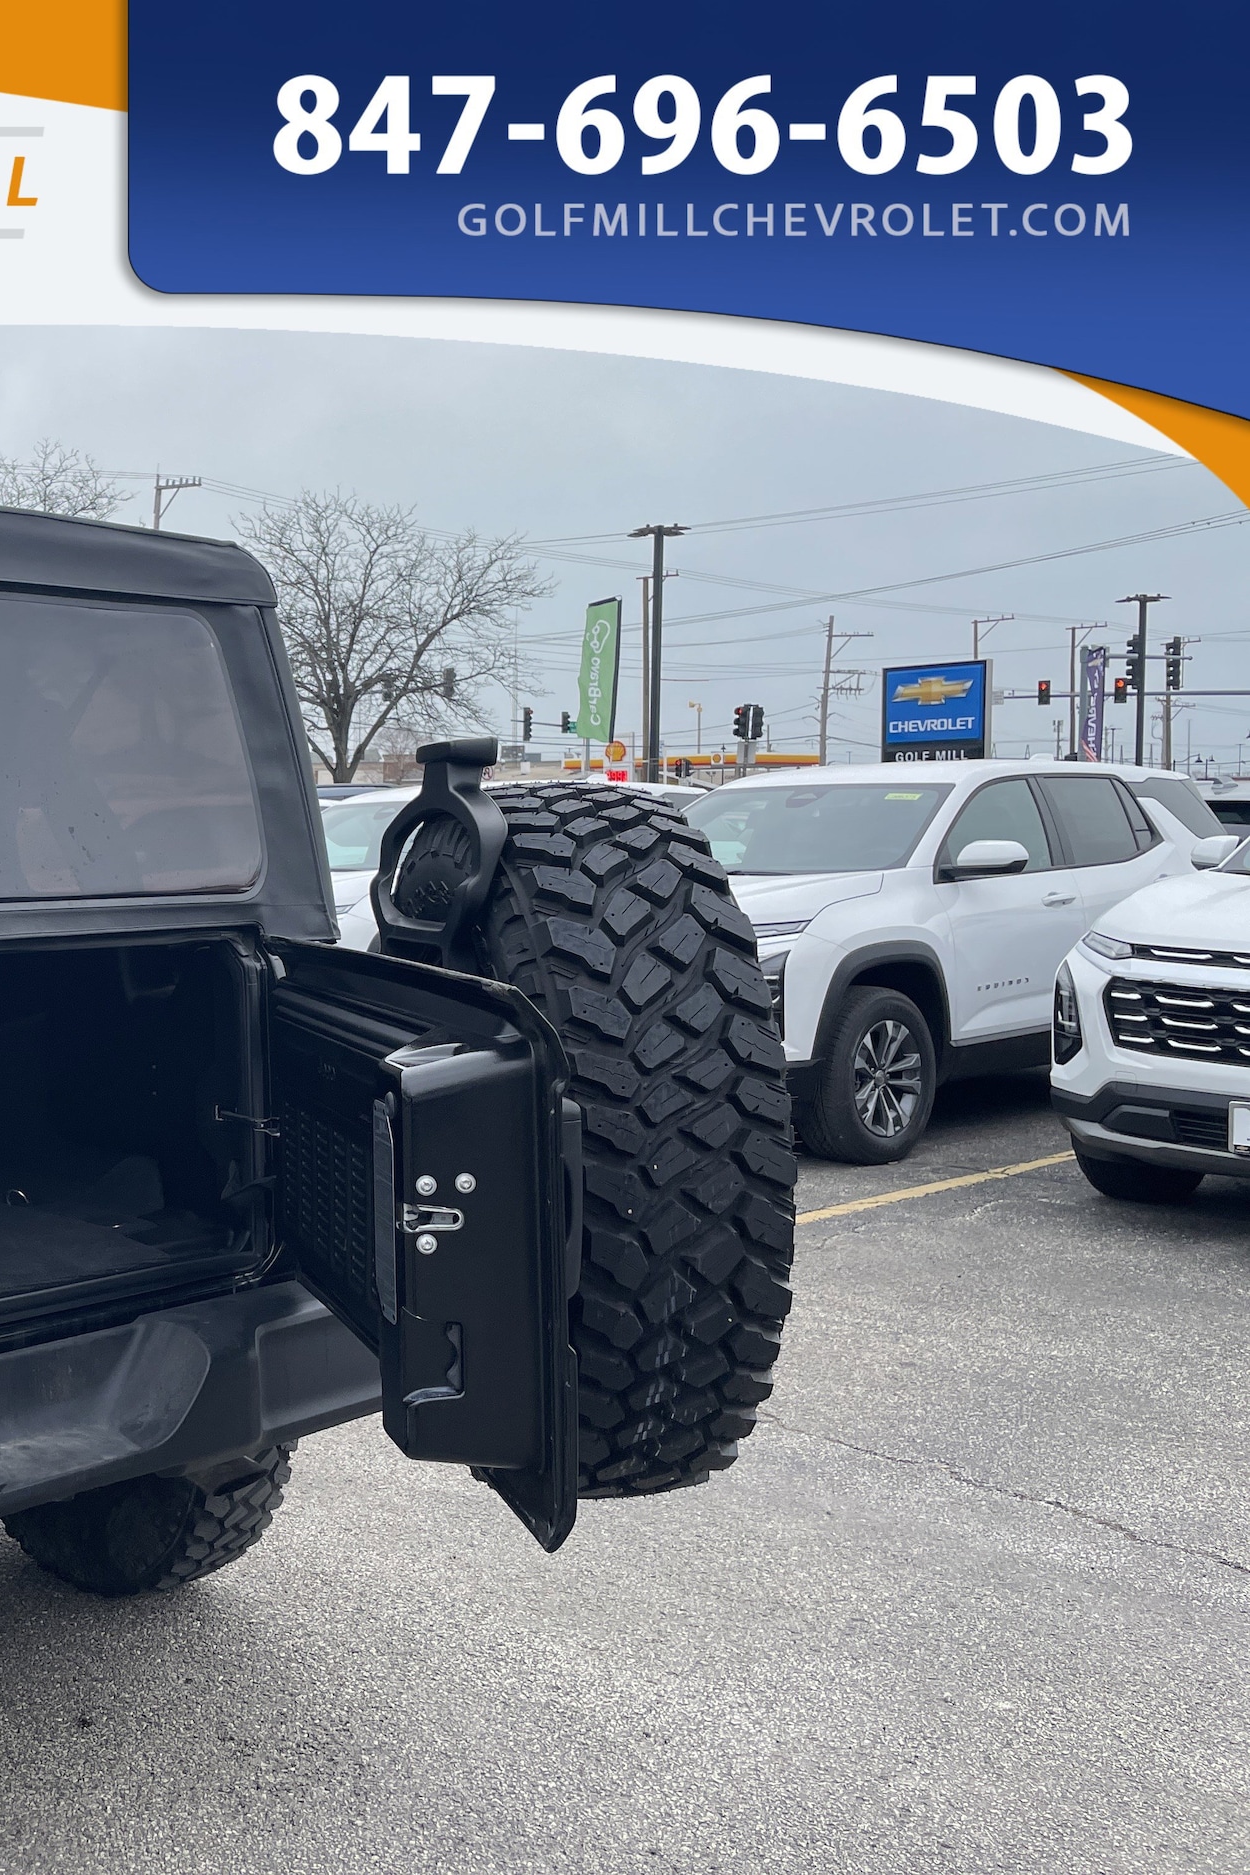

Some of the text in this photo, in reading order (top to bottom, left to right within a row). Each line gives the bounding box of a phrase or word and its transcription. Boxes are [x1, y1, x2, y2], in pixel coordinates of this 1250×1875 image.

[889, 717, 976, 733] CHEVROLET
[895, 749, 968, 762] GOLF MILL
